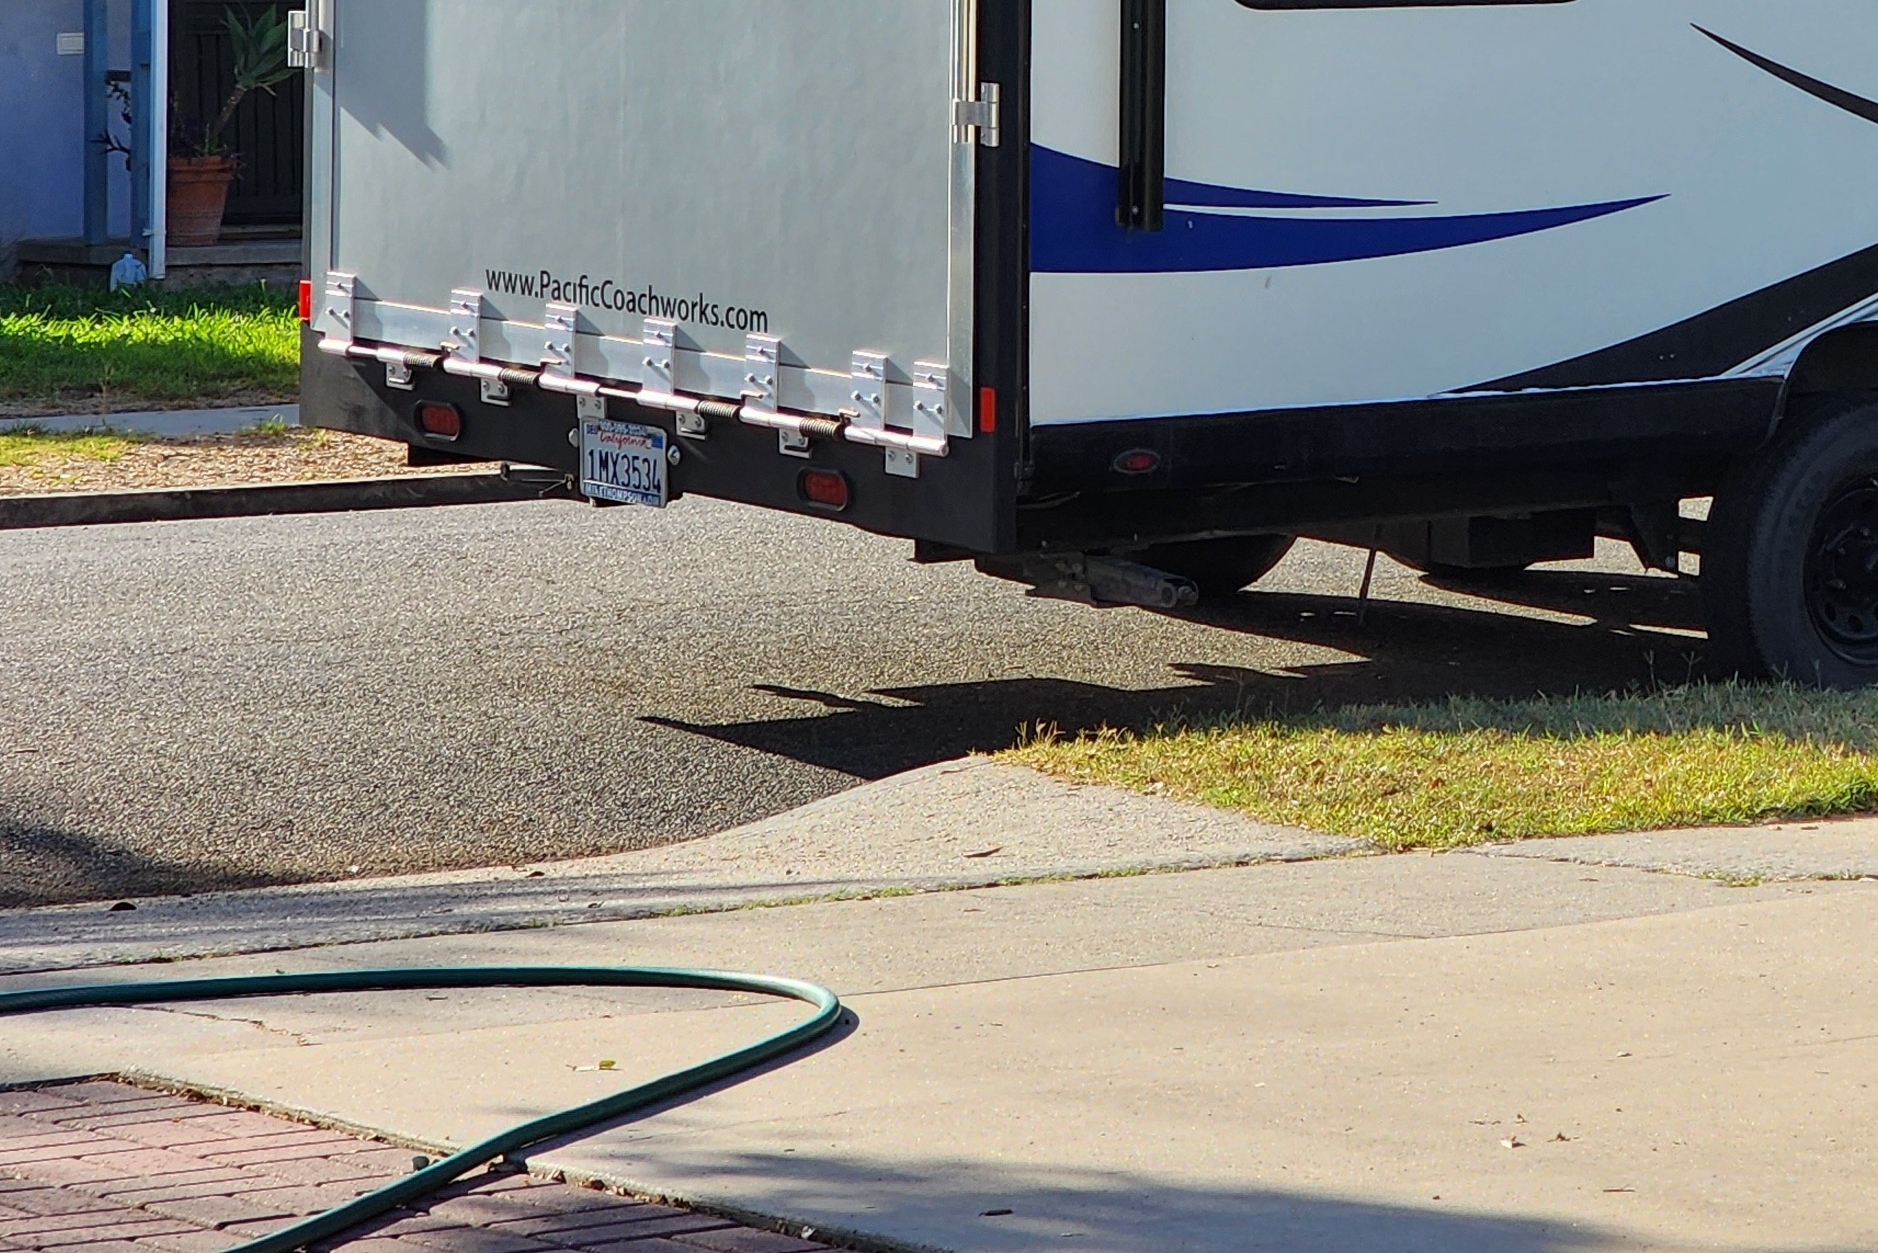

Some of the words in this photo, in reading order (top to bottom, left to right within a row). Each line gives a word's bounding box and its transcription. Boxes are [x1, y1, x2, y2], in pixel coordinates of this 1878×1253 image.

[485, 268, 769, 334] www.PacificCoachworks.com
[600, 431, 651, 450] California
[588, 449, 661, 493] 1MX3534
